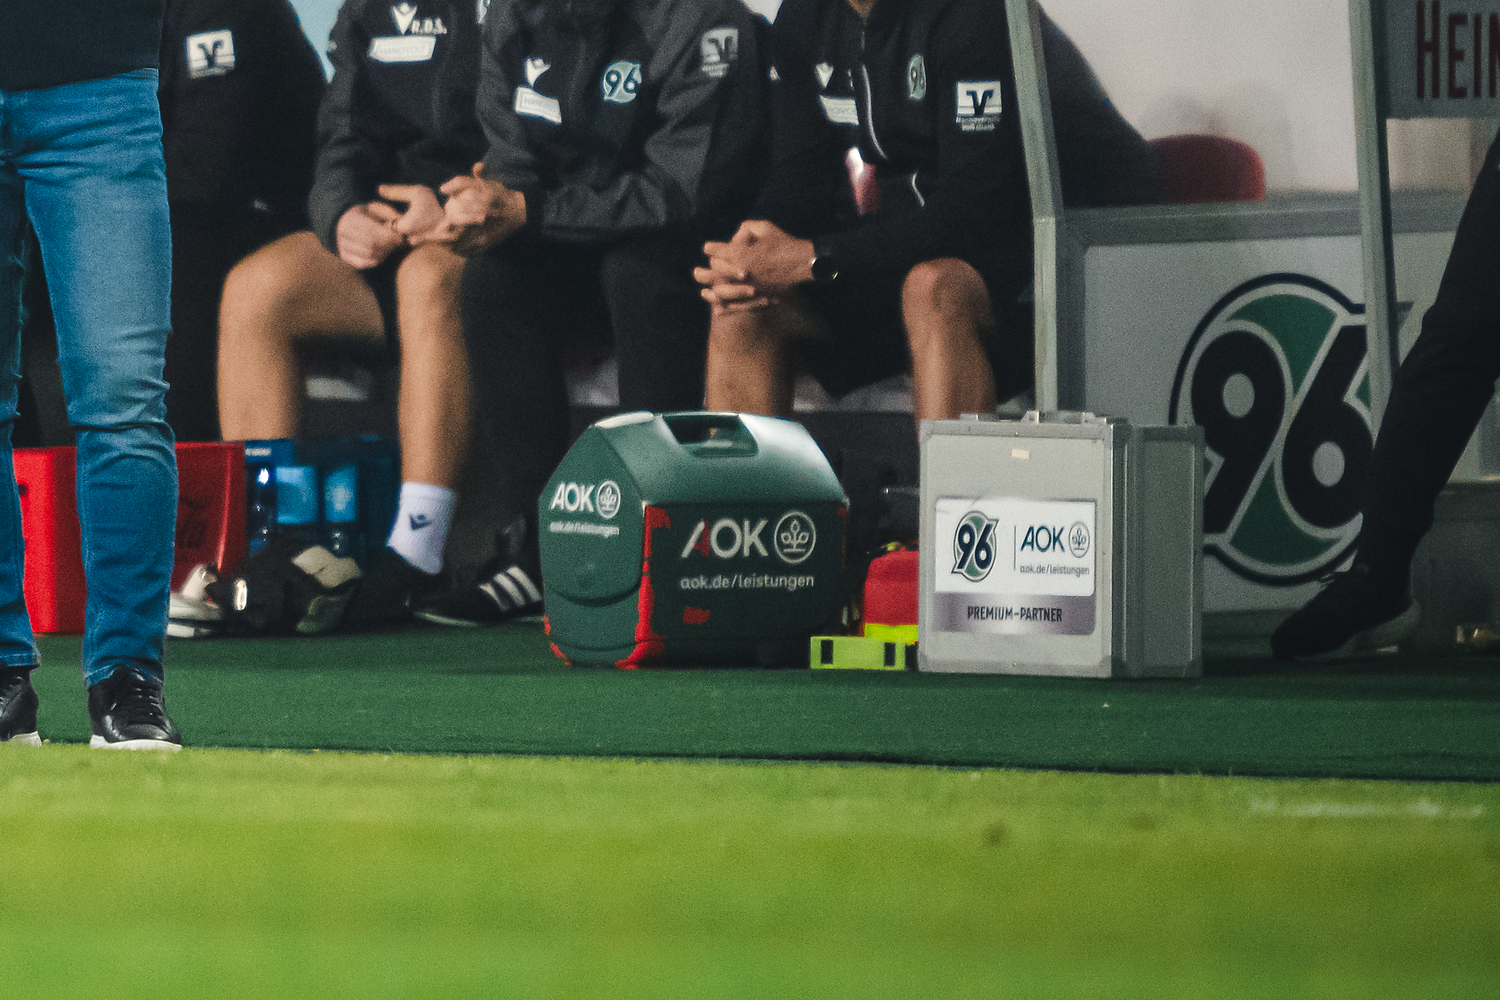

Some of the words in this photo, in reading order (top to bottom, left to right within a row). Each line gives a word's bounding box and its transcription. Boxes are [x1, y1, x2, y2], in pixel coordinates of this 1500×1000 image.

[605, 65, 638, 97] 96
[1190, 324, 1376, 535] 96
[549, 482, 595, 512] AOK
[681, 518, 769, 559] AOK
[956, 521, 994, 571] 96
[1020, 525, 1066, 553] AOK
[680, 573, 815, 592] aok.de/leistungen
[1019, 563, 1091, 578] aok.de/leistungen
[967, 605, 1063, 622] PREMIUM-PARTNER
